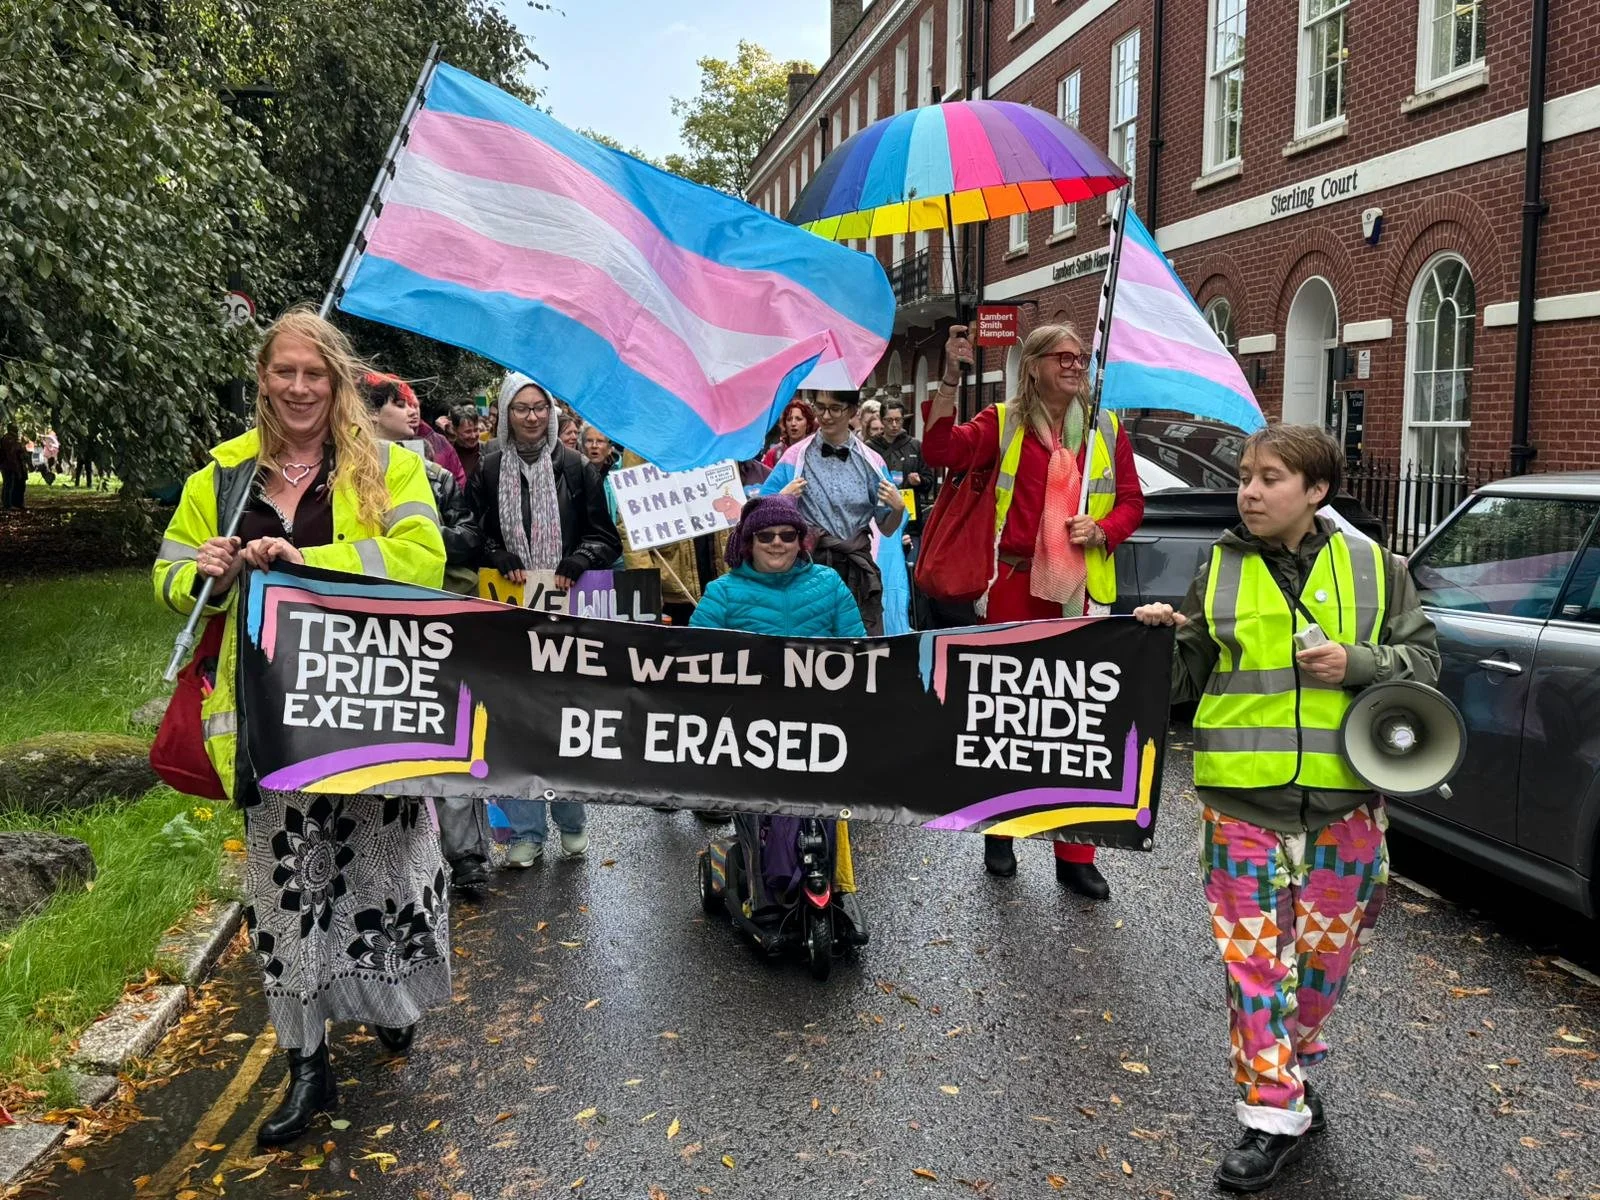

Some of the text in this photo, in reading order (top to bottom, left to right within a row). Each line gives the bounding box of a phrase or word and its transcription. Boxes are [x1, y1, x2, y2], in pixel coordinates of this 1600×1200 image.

[1271, 169, 1358, 215] Sterling Court
[980, 321, 1003, 329] Smith
[980, 329, 1015, 338] Hampton
[613, 469, 638, 490] IN
[627, 482, 708, 516] BINARY
[630, 511, 716, 545] FINERY
[577, 588, 657, 622] WILL
[289, 611, 454, 660] TRANS
[295, 652, 440, 699] PRIDE
[527, 630, 890, 693] WE WILL NOT
[958, 653, 1122, 702] TRANS
[282, 692, 445, 734] EXETER
[966, 693, 1107, 742] PRIDE
[558, 707, 848, 773] BE ERASED
[955, 734, 1113, 779] EXETER
